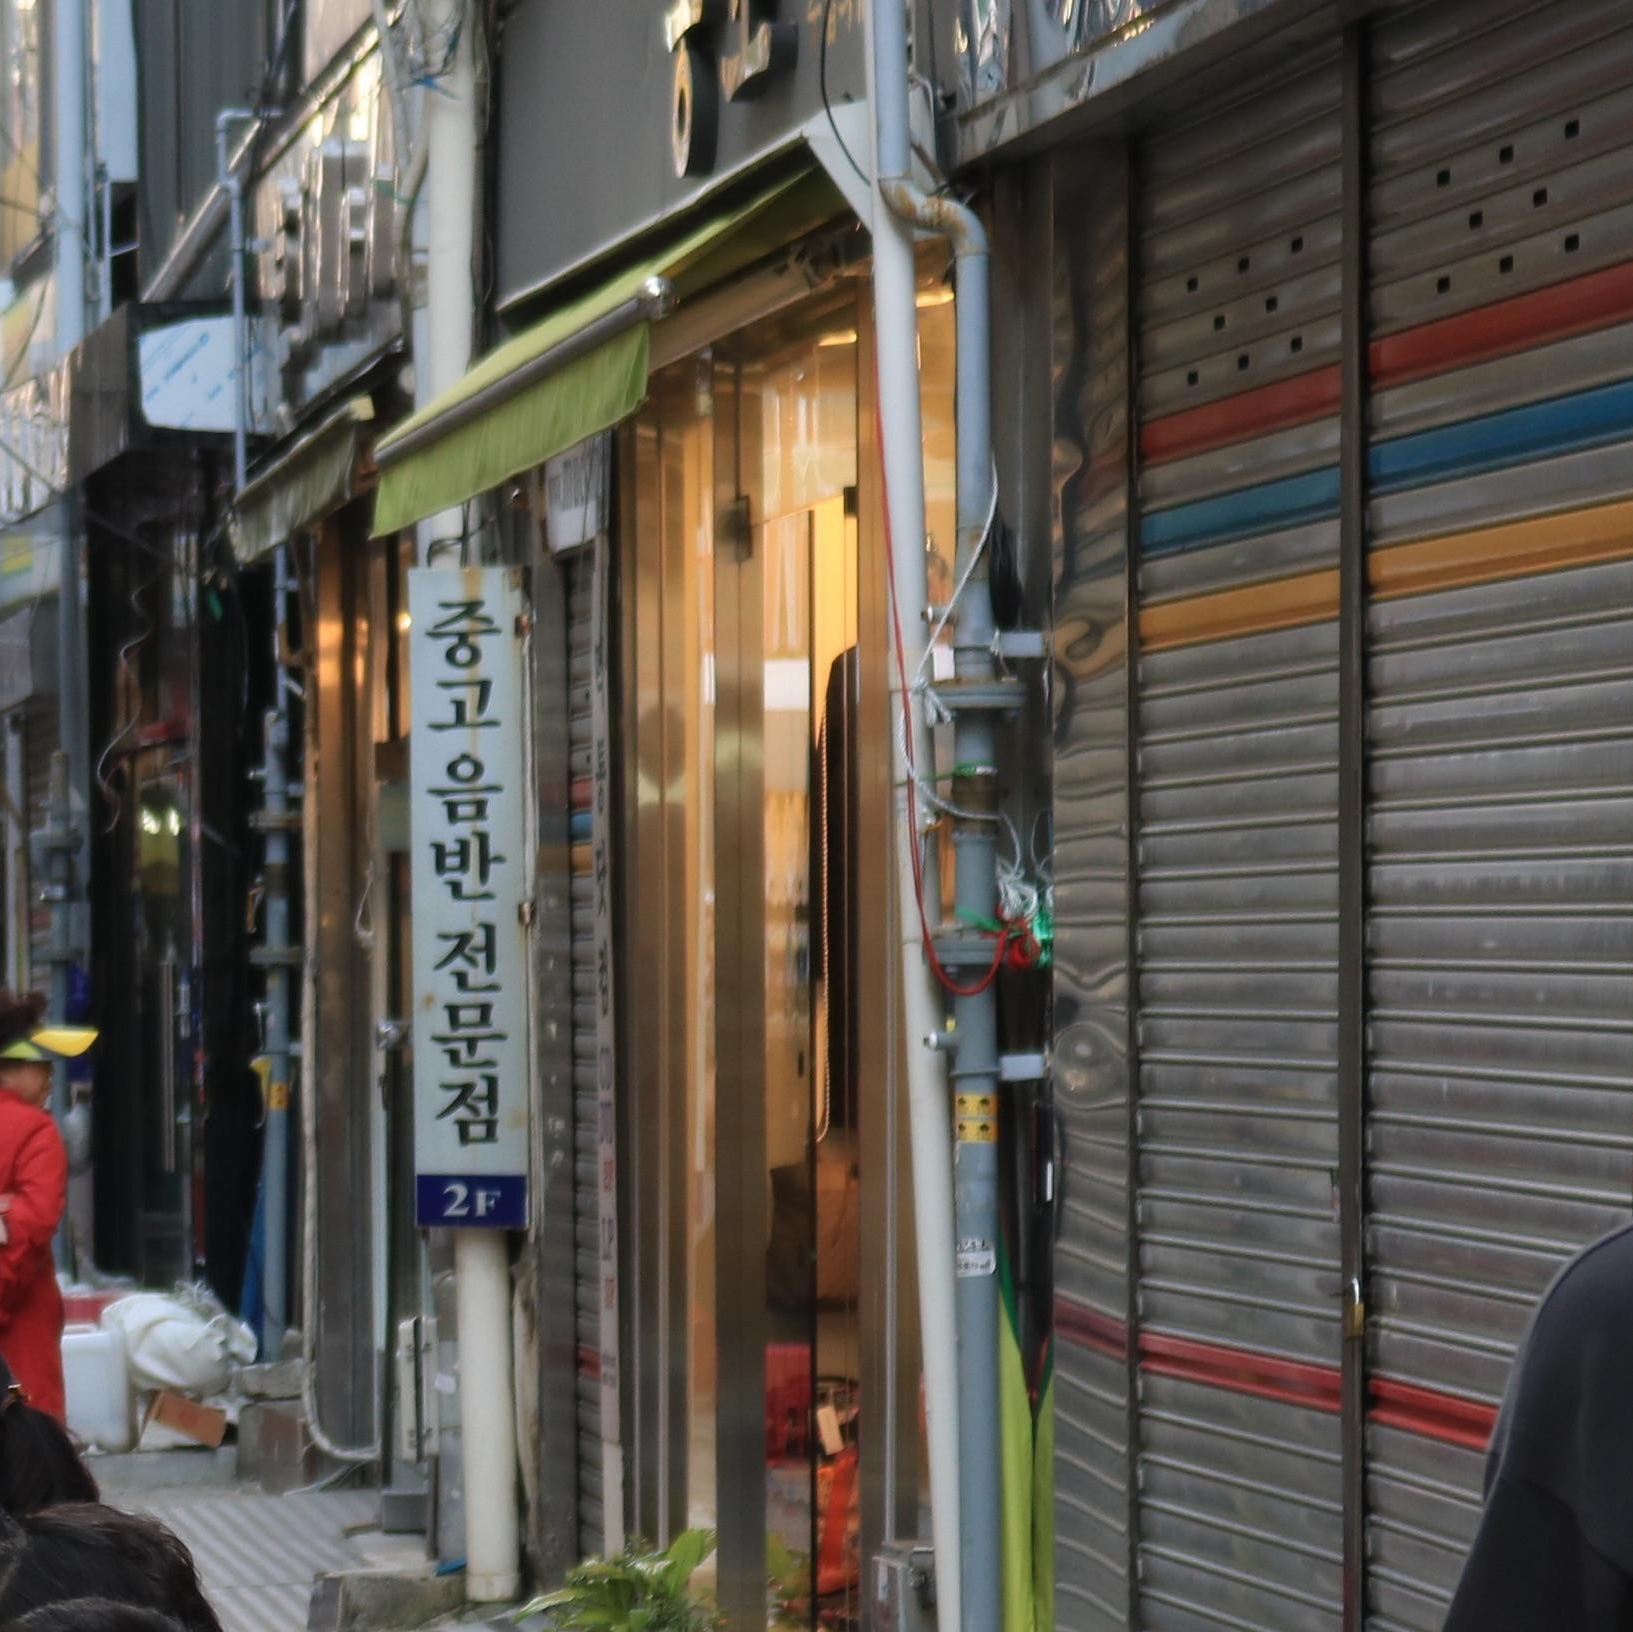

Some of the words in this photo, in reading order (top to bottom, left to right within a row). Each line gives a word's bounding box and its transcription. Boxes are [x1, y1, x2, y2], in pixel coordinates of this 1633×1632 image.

[425, 600, 503, 733] 중고
[426, 752, 506, 902] 음반
[430, 921, 509, 1148] 전문점
[442, 1184, 502, 1218] 2F
